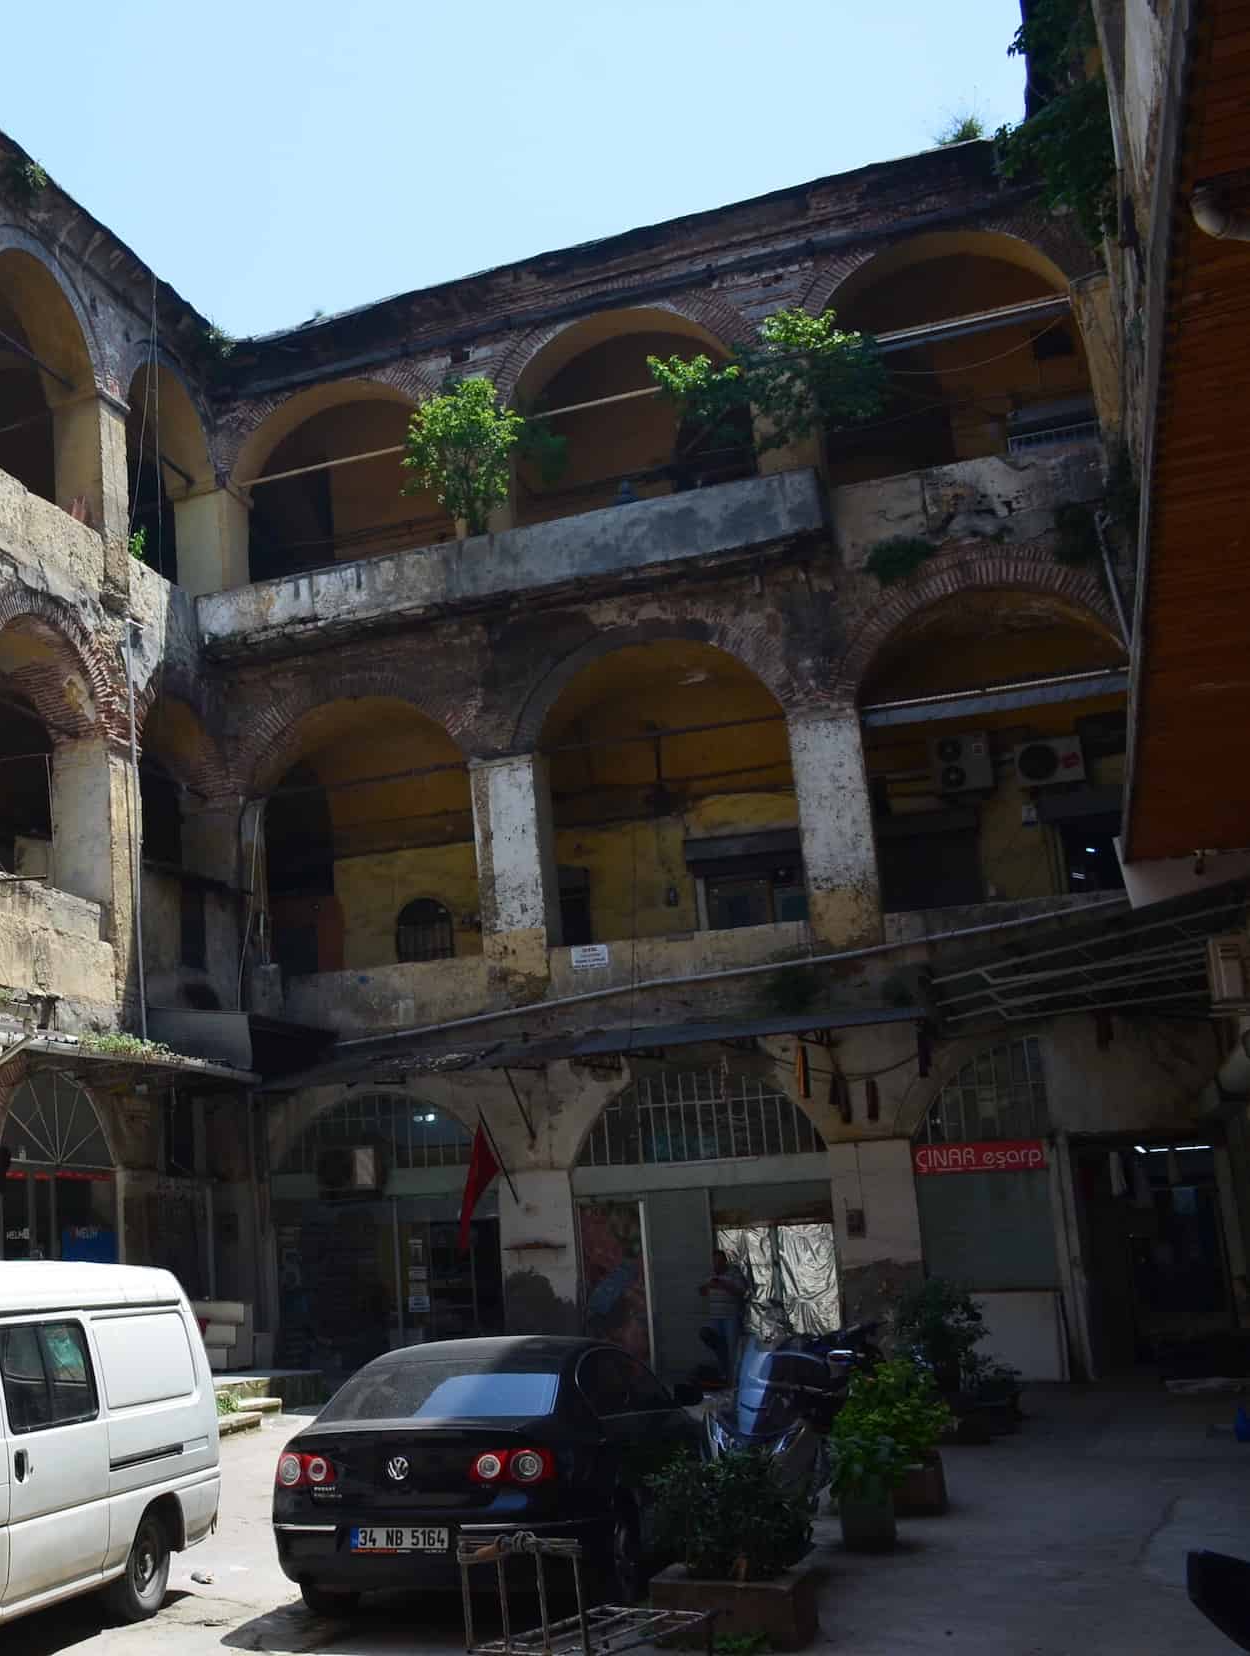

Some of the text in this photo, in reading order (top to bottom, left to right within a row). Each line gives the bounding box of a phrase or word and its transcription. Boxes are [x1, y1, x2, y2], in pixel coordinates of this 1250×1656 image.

[982, 1149, 1042, 1168] eşarp
[359, 1529, 377, 1546] 34
[385, 1529, 404, 1546] NB
[411, 1529, 446, 1546] 5164
